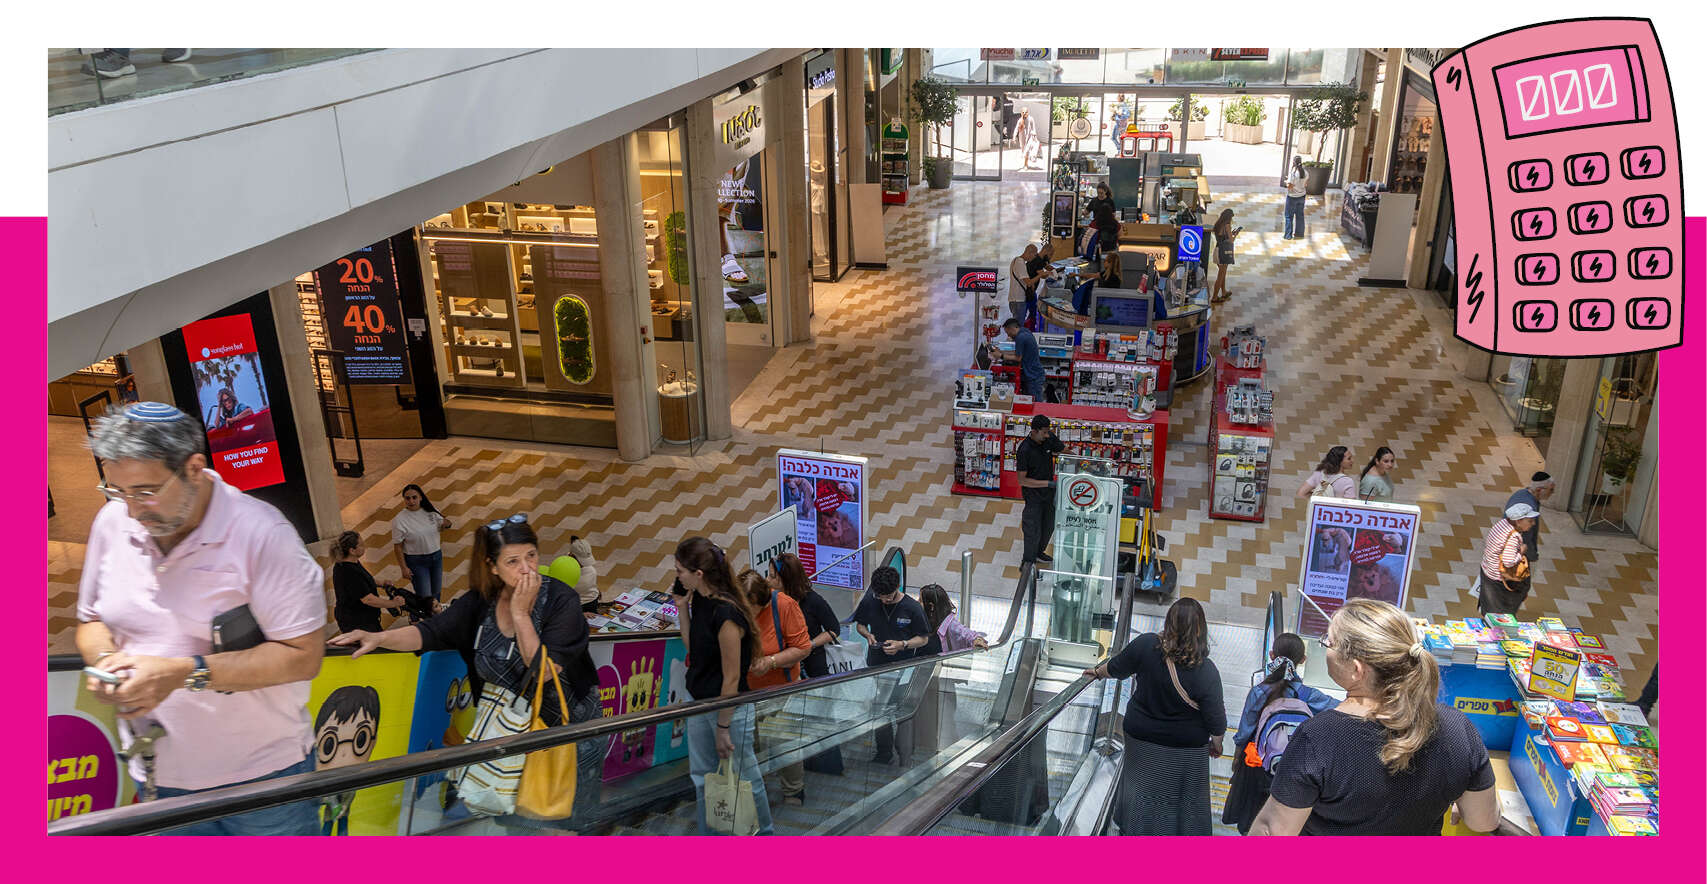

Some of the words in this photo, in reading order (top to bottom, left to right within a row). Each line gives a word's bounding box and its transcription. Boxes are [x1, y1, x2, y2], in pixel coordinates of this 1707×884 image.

[721, 180, 740, 188] NEW
[347, 284, 370, 292] הנחה
[354, 335, 381, 344] הנחה
[223, 453, 239, 461] HOW
[240, 449, 253, 458] YOU
[254, 446, 268, 456] FIND
[232, 459, 250, 469] YOUR
[250, 456, 264, 465] WAY
[783, 459, 820, 475] כלבה!
[823, 464, 859, 480] אבדה
[1318, 507, 1363, 525] כלבה!
[1367, 514, 1412, 530] אבדה
[756, 534, 793, 566] למרחב
[1544, 671, 1564, 680] הנחה
[1457, 700, 1489, 711] ספרים
